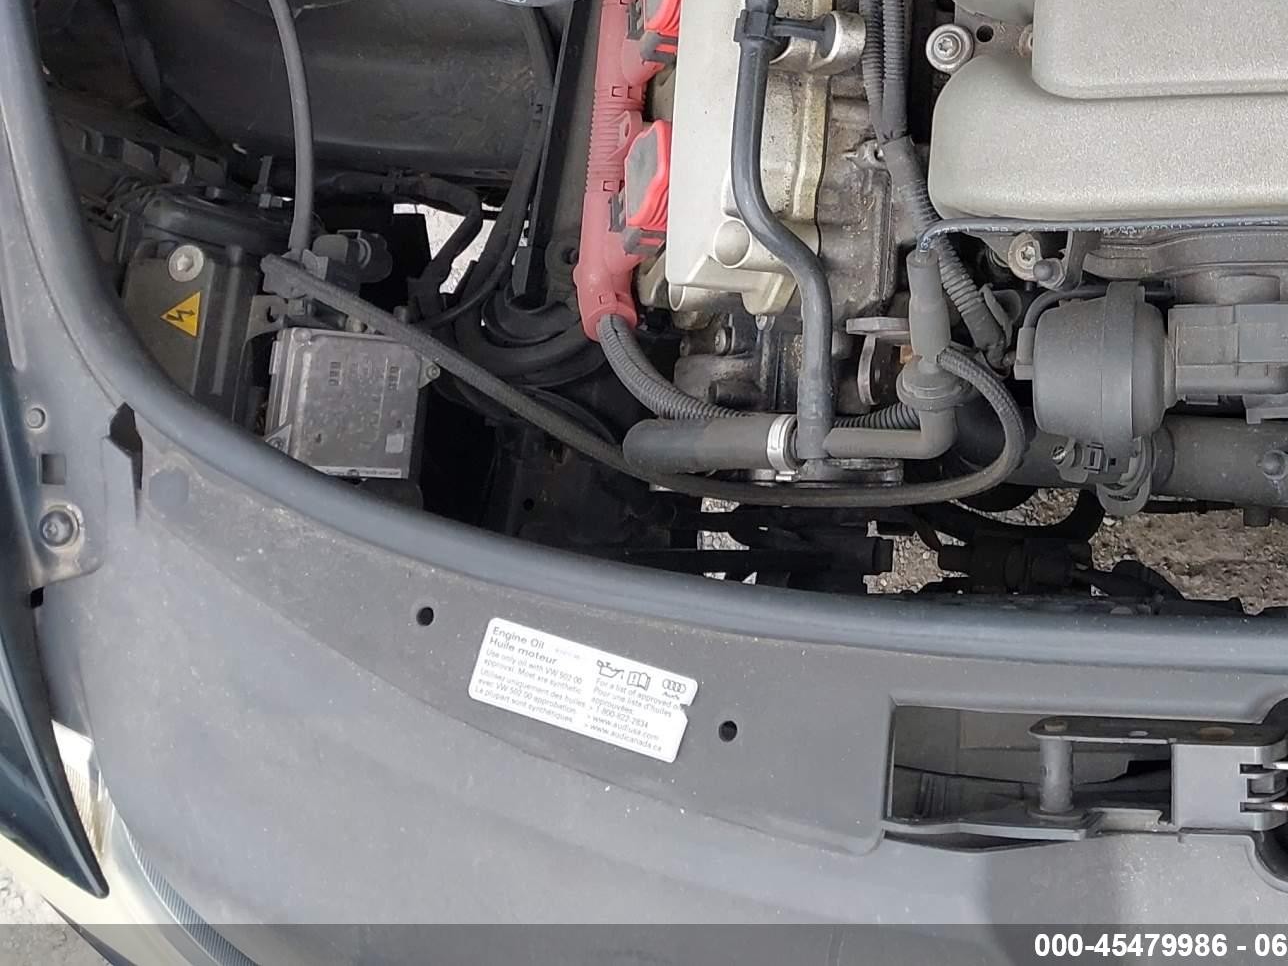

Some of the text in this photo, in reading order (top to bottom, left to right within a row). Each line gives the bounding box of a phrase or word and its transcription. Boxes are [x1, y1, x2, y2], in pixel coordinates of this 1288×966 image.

[492, 625, 545, 650] Engine Oil
[488, 635, 516, 653] Huile
[518, 646, 558, 665] moteur
[485, 648, 500, 658] Use
[500, 654, 516, 665] only
[517, 658, 527, 666] oil
[528, 662, 543, 671] with
[544, 667, 558, 677] VW
[517, 667, 535, 678] Most
[537, 674, 549, 683] are
[483, 689, 510, 703] plupart
[510, 698, 526, 707] sont
[495, 682, 508, 691] VW
[509, 686, 523, 696] 502
[522, 691, 533, 700] 00
[549, 690, 562, 699] des
[592, 686, 611, 698] Pour
[612, 693, 625, 702] une
[595, 677, 609, 688] For
[614, 683, 627, 693] list
[627, 688, 637, 696] of
[637, 692, 672, 708] approved
